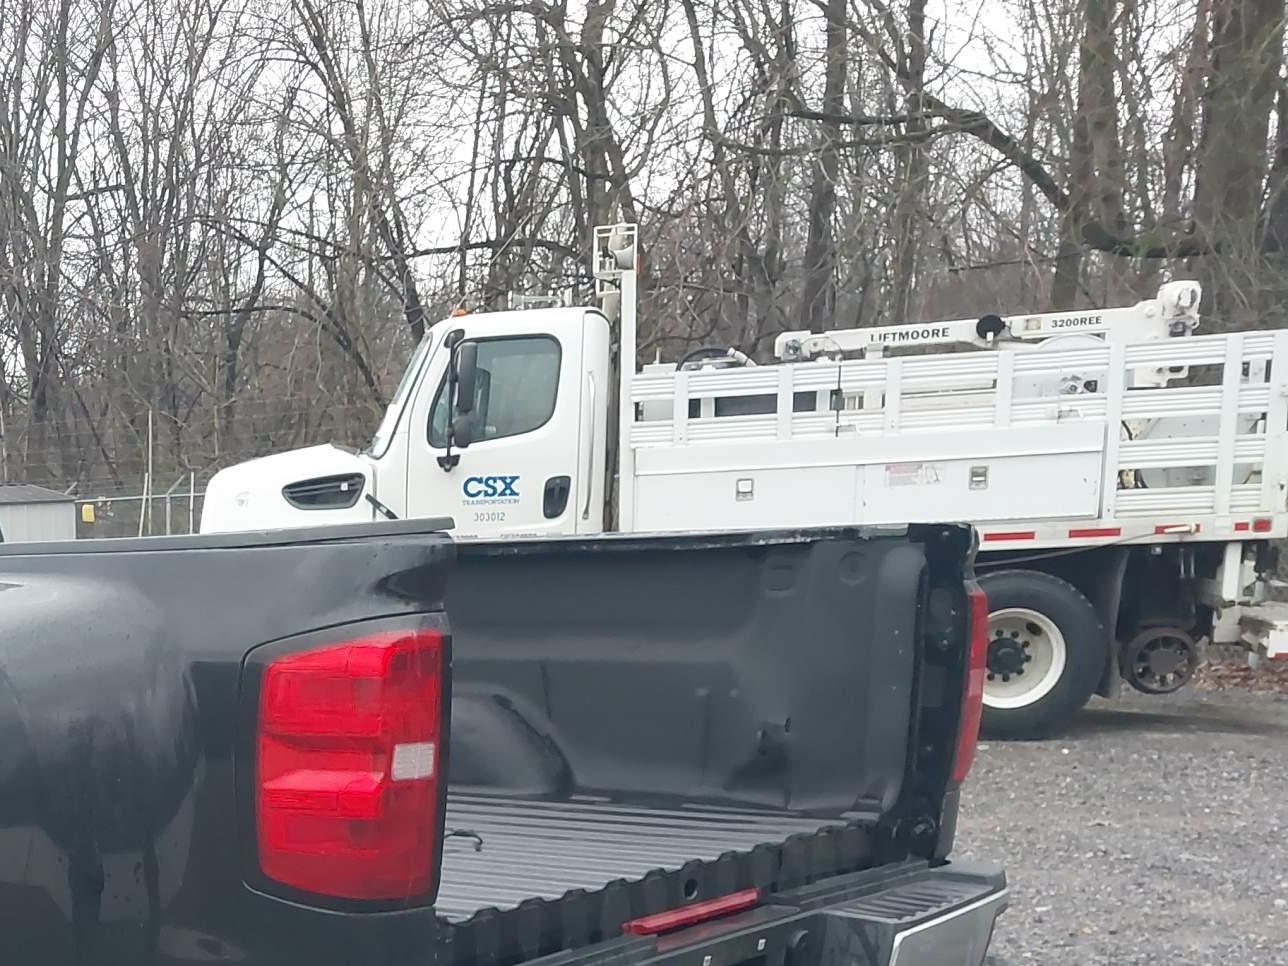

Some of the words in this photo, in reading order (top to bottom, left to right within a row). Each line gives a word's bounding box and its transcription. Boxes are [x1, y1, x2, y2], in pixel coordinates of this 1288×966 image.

[1051, 315, 1103, 328] 3200REE
[463, 476, 520, 498] CSX
[473, 512, 506, 521] 303012
